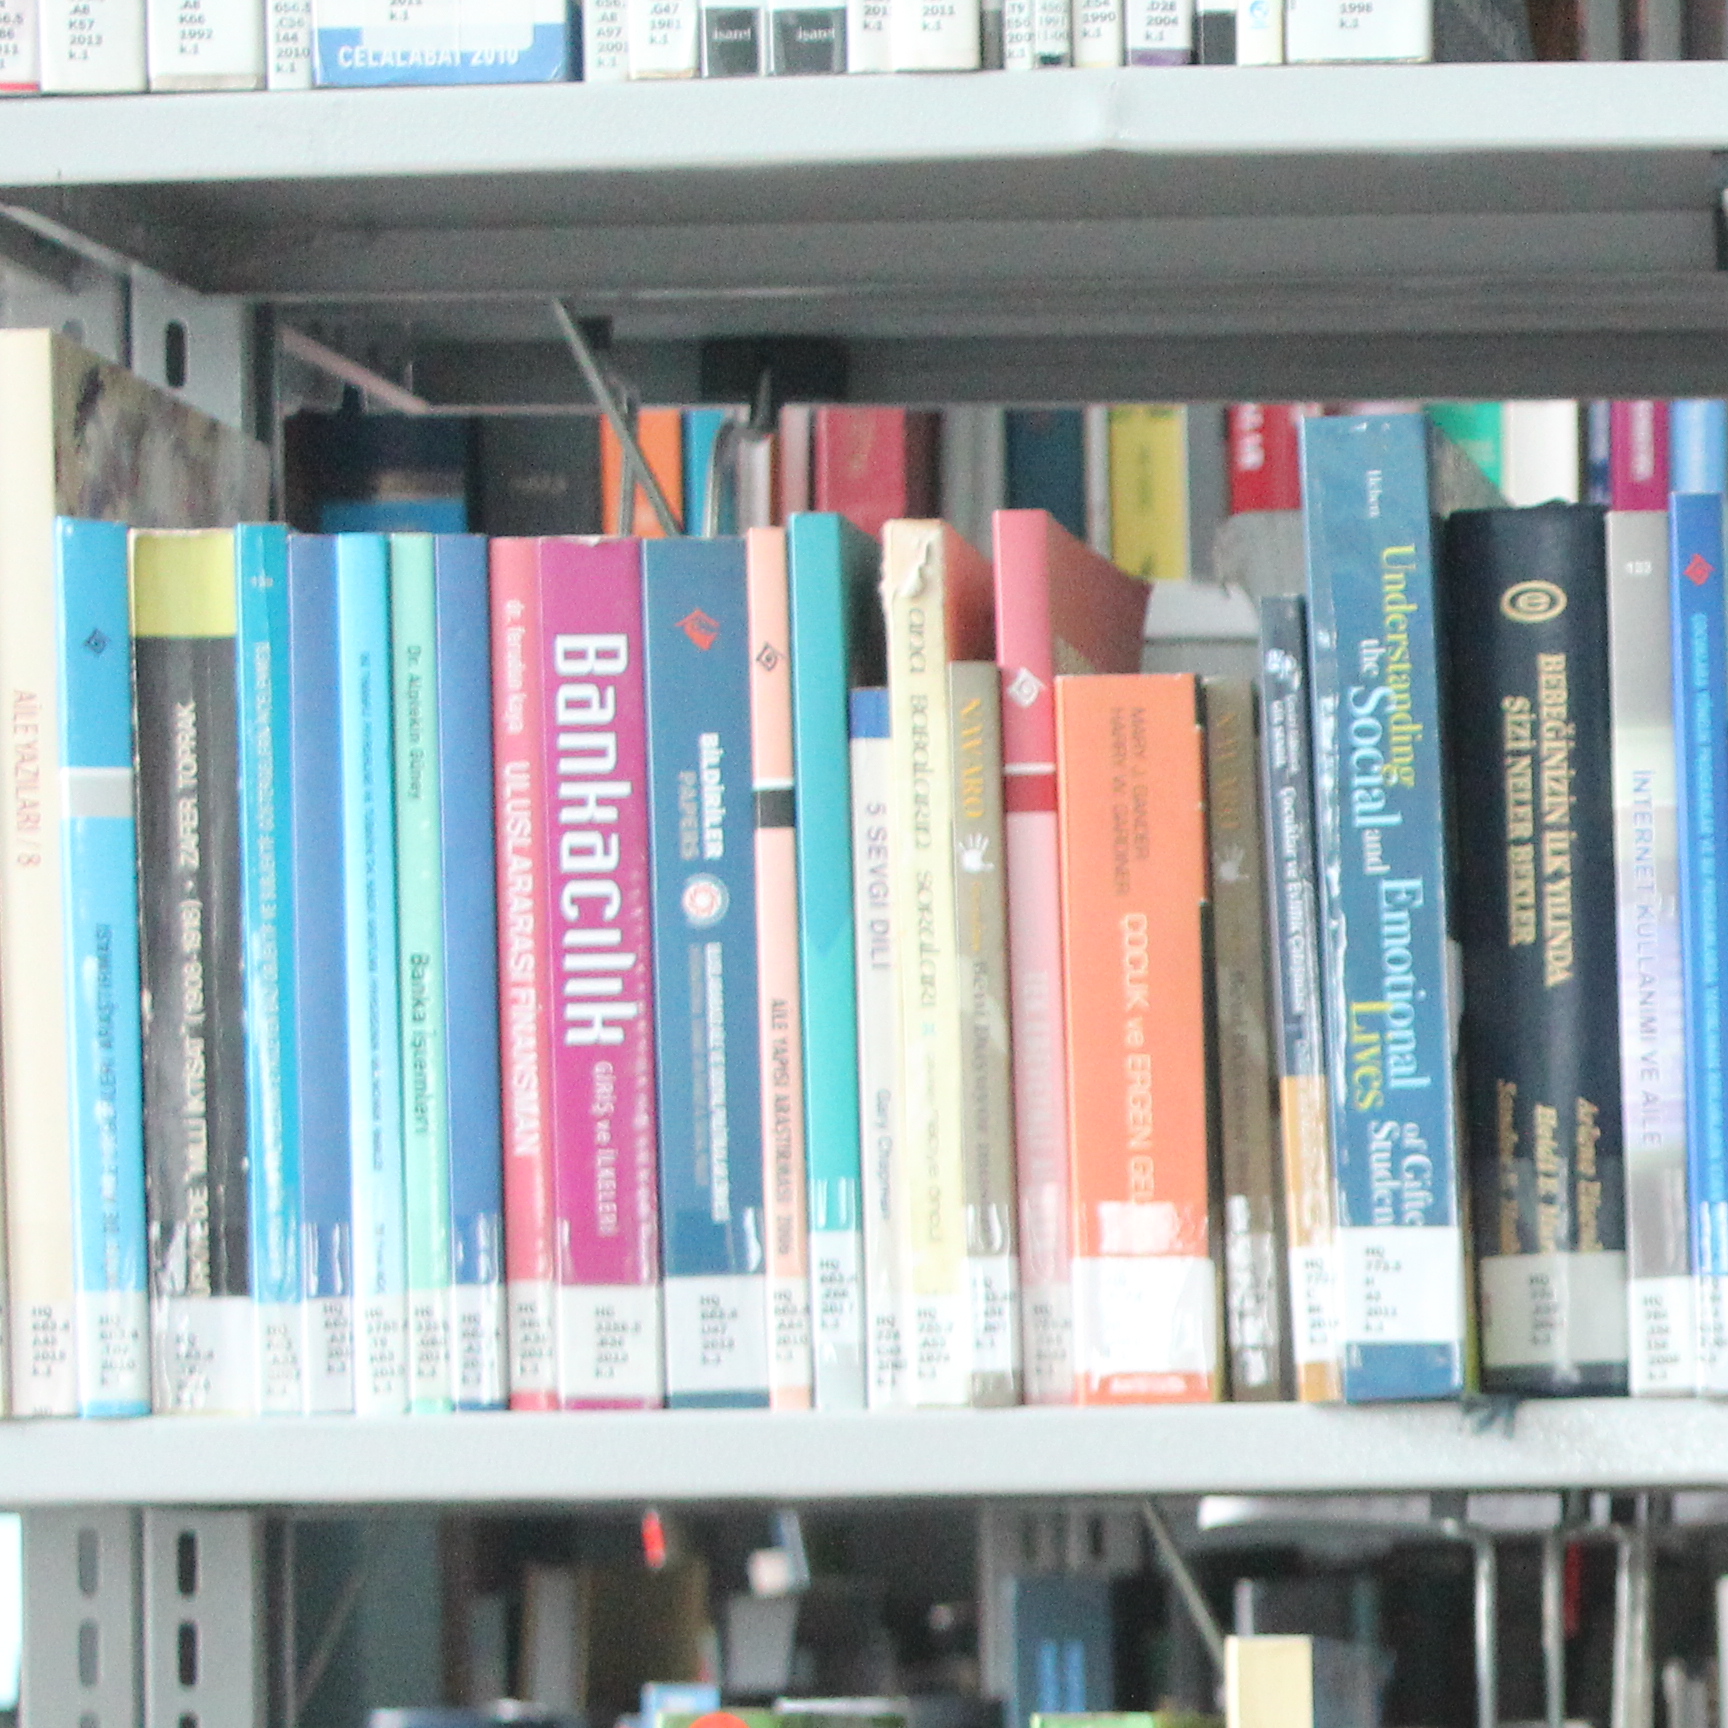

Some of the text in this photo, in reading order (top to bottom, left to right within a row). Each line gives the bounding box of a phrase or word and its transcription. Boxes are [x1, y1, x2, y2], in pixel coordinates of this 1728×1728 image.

[1381, 545, 1422, 788] Understanding
[175, 701, 202, 868] ZAFER TOPRAK
[503, 761, 536, 985] ULUSLARARASI
[553, 633, 640, 1047] Bankacılık
[698, 732, 727, 861] BİLDİRİLER
[867, 826, 892, 911] SEVGİ
[1347, 640, 1431, 1090] the Social and Emotional
[1505, 757, 1536, 947] NELER BEKLER
[1537, 653, 1578, 987] BEBEĞİNİZİN İLK YILINDA
[1631, 755, 1658, 880] İNTERNET
[868, 918, 896, 970] DİLİ
[1635, 889, 1658, 1031] KULLANIMI
[509, 989, 542, 1157] FİNANSMAN
[1121, 912, 1155, 1204] ÇOCUK ve ERGEN GEL
[1349, 1001, 1433, 1228] Lives of Gifte
[1369, 1122, 1402, 1228] Studen
